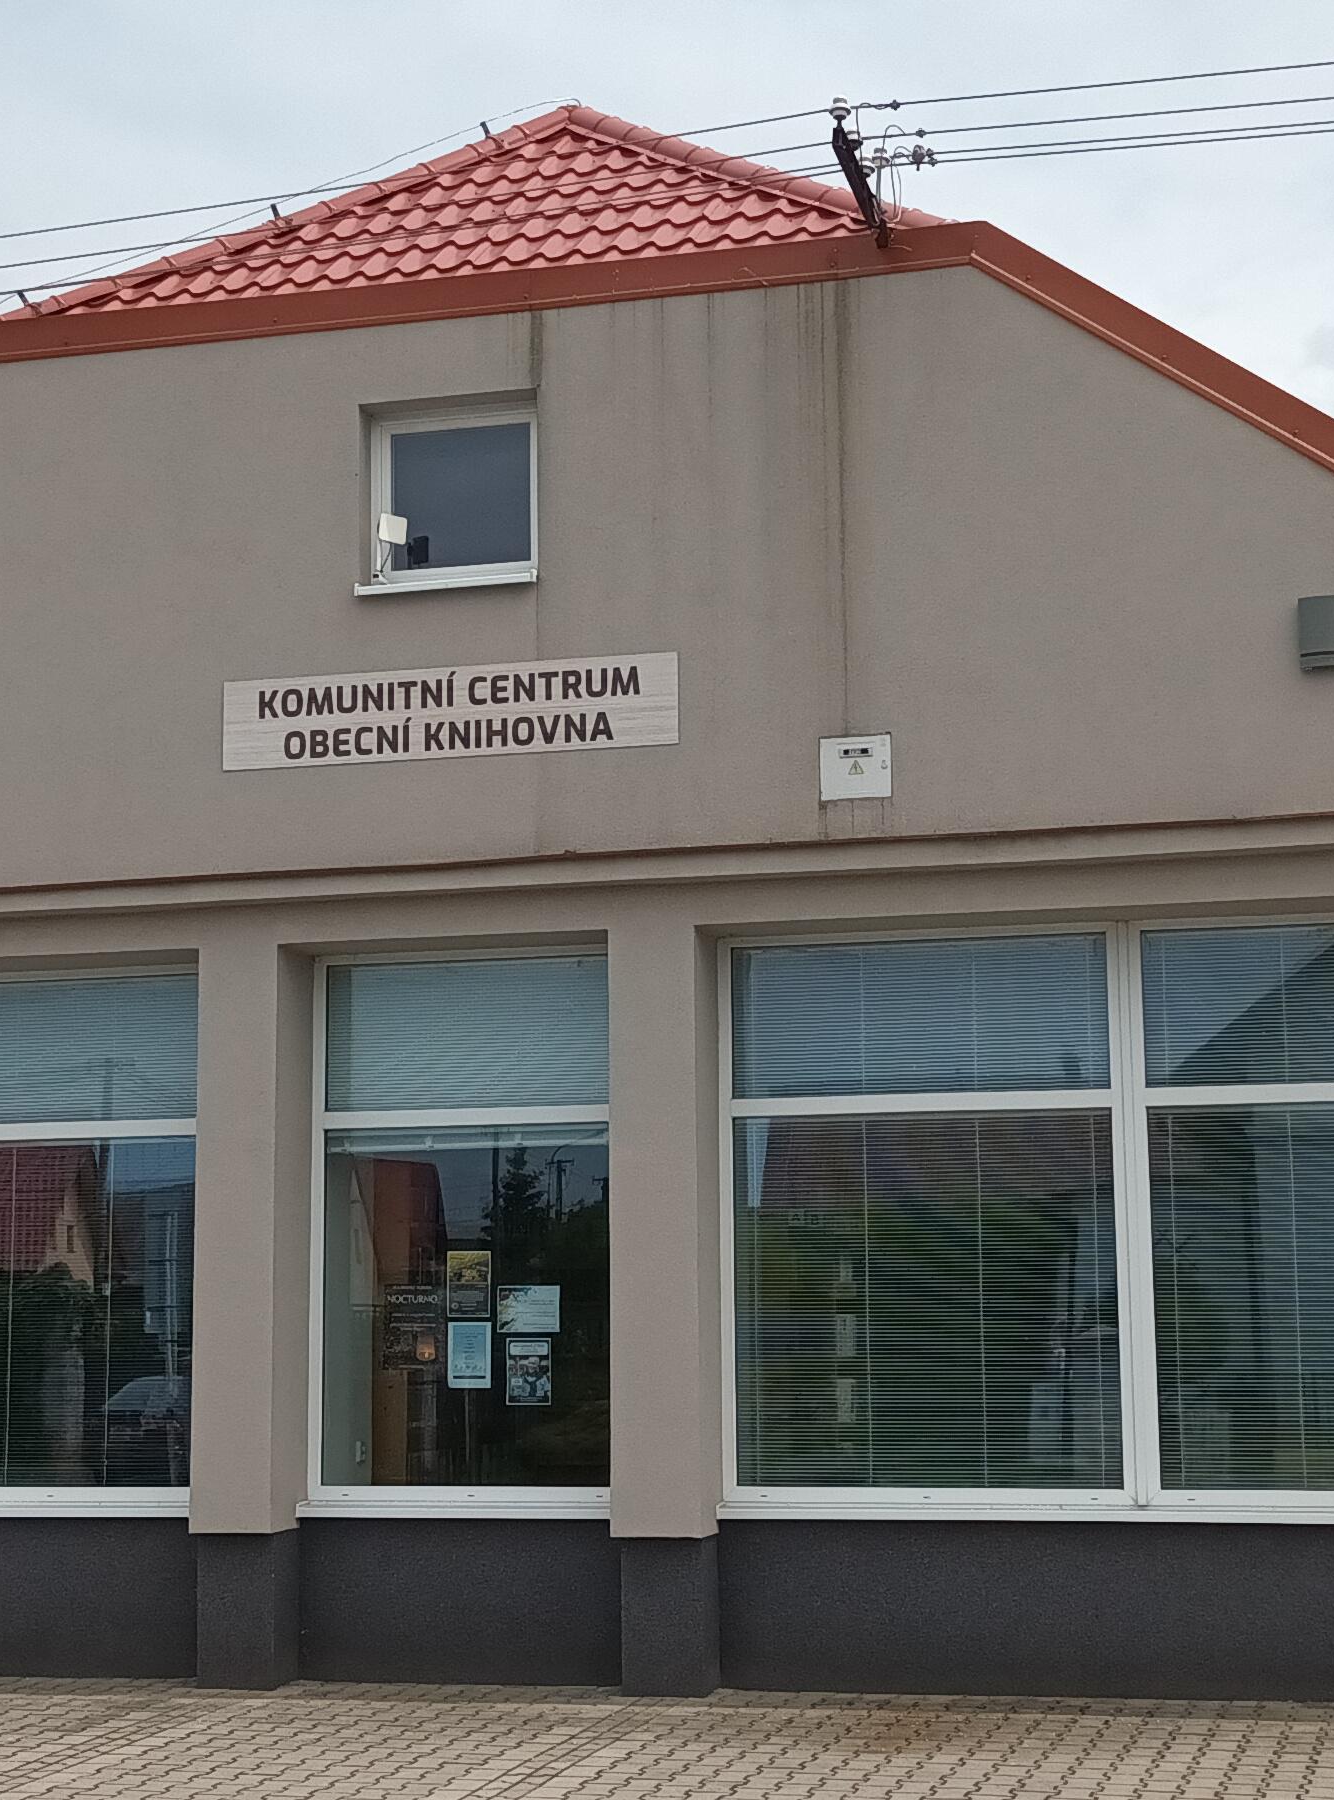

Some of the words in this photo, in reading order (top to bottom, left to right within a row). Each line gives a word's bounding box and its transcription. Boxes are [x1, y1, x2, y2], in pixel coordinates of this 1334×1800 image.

[258, 672, 457, 719] KOMUNITNÍ
[468, 665, 641, 706] CENTRUM
[283, 718, 411, 760] OBECNÍ
[424, 712, 614, 753] KNIHOVNA
